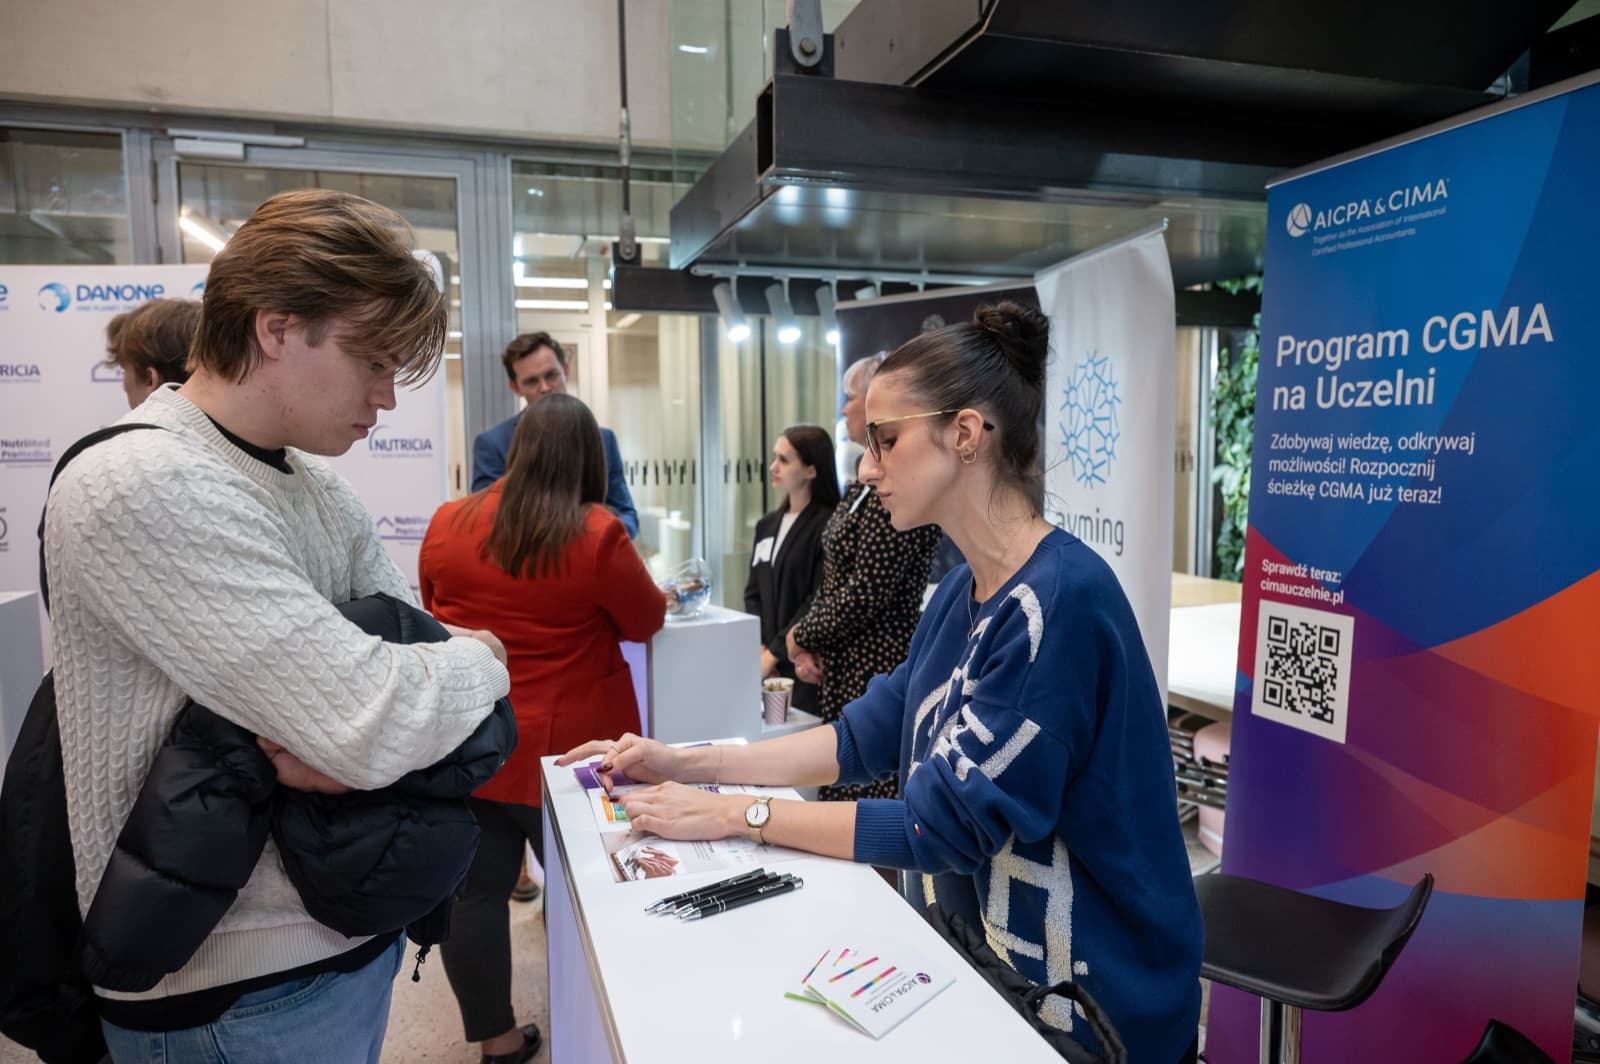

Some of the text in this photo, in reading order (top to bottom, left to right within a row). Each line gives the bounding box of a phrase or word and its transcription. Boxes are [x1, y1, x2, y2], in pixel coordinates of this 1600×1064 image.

[1313, 178, 1449, 231] AICPA & CIMA
[1276, 303, 1554, 371] Program CGMA
[1272, 368, 1436, 411] na Uczelni
[374, 437, 433, 452] NUTRICIA
[1270, 432, 1476, 456] Zdobywaj wiedzę, odkrywaj
[1269, 457, 1436, 482] możliwości! Rozpocznij
[1267, 480, 1442, 504] ścieżkę CGMA już teraz!
[1261, 559, 1342, 583] Sprawdź teraz:
[1260, 578, 1344, 606] cimauczelnie.pl
